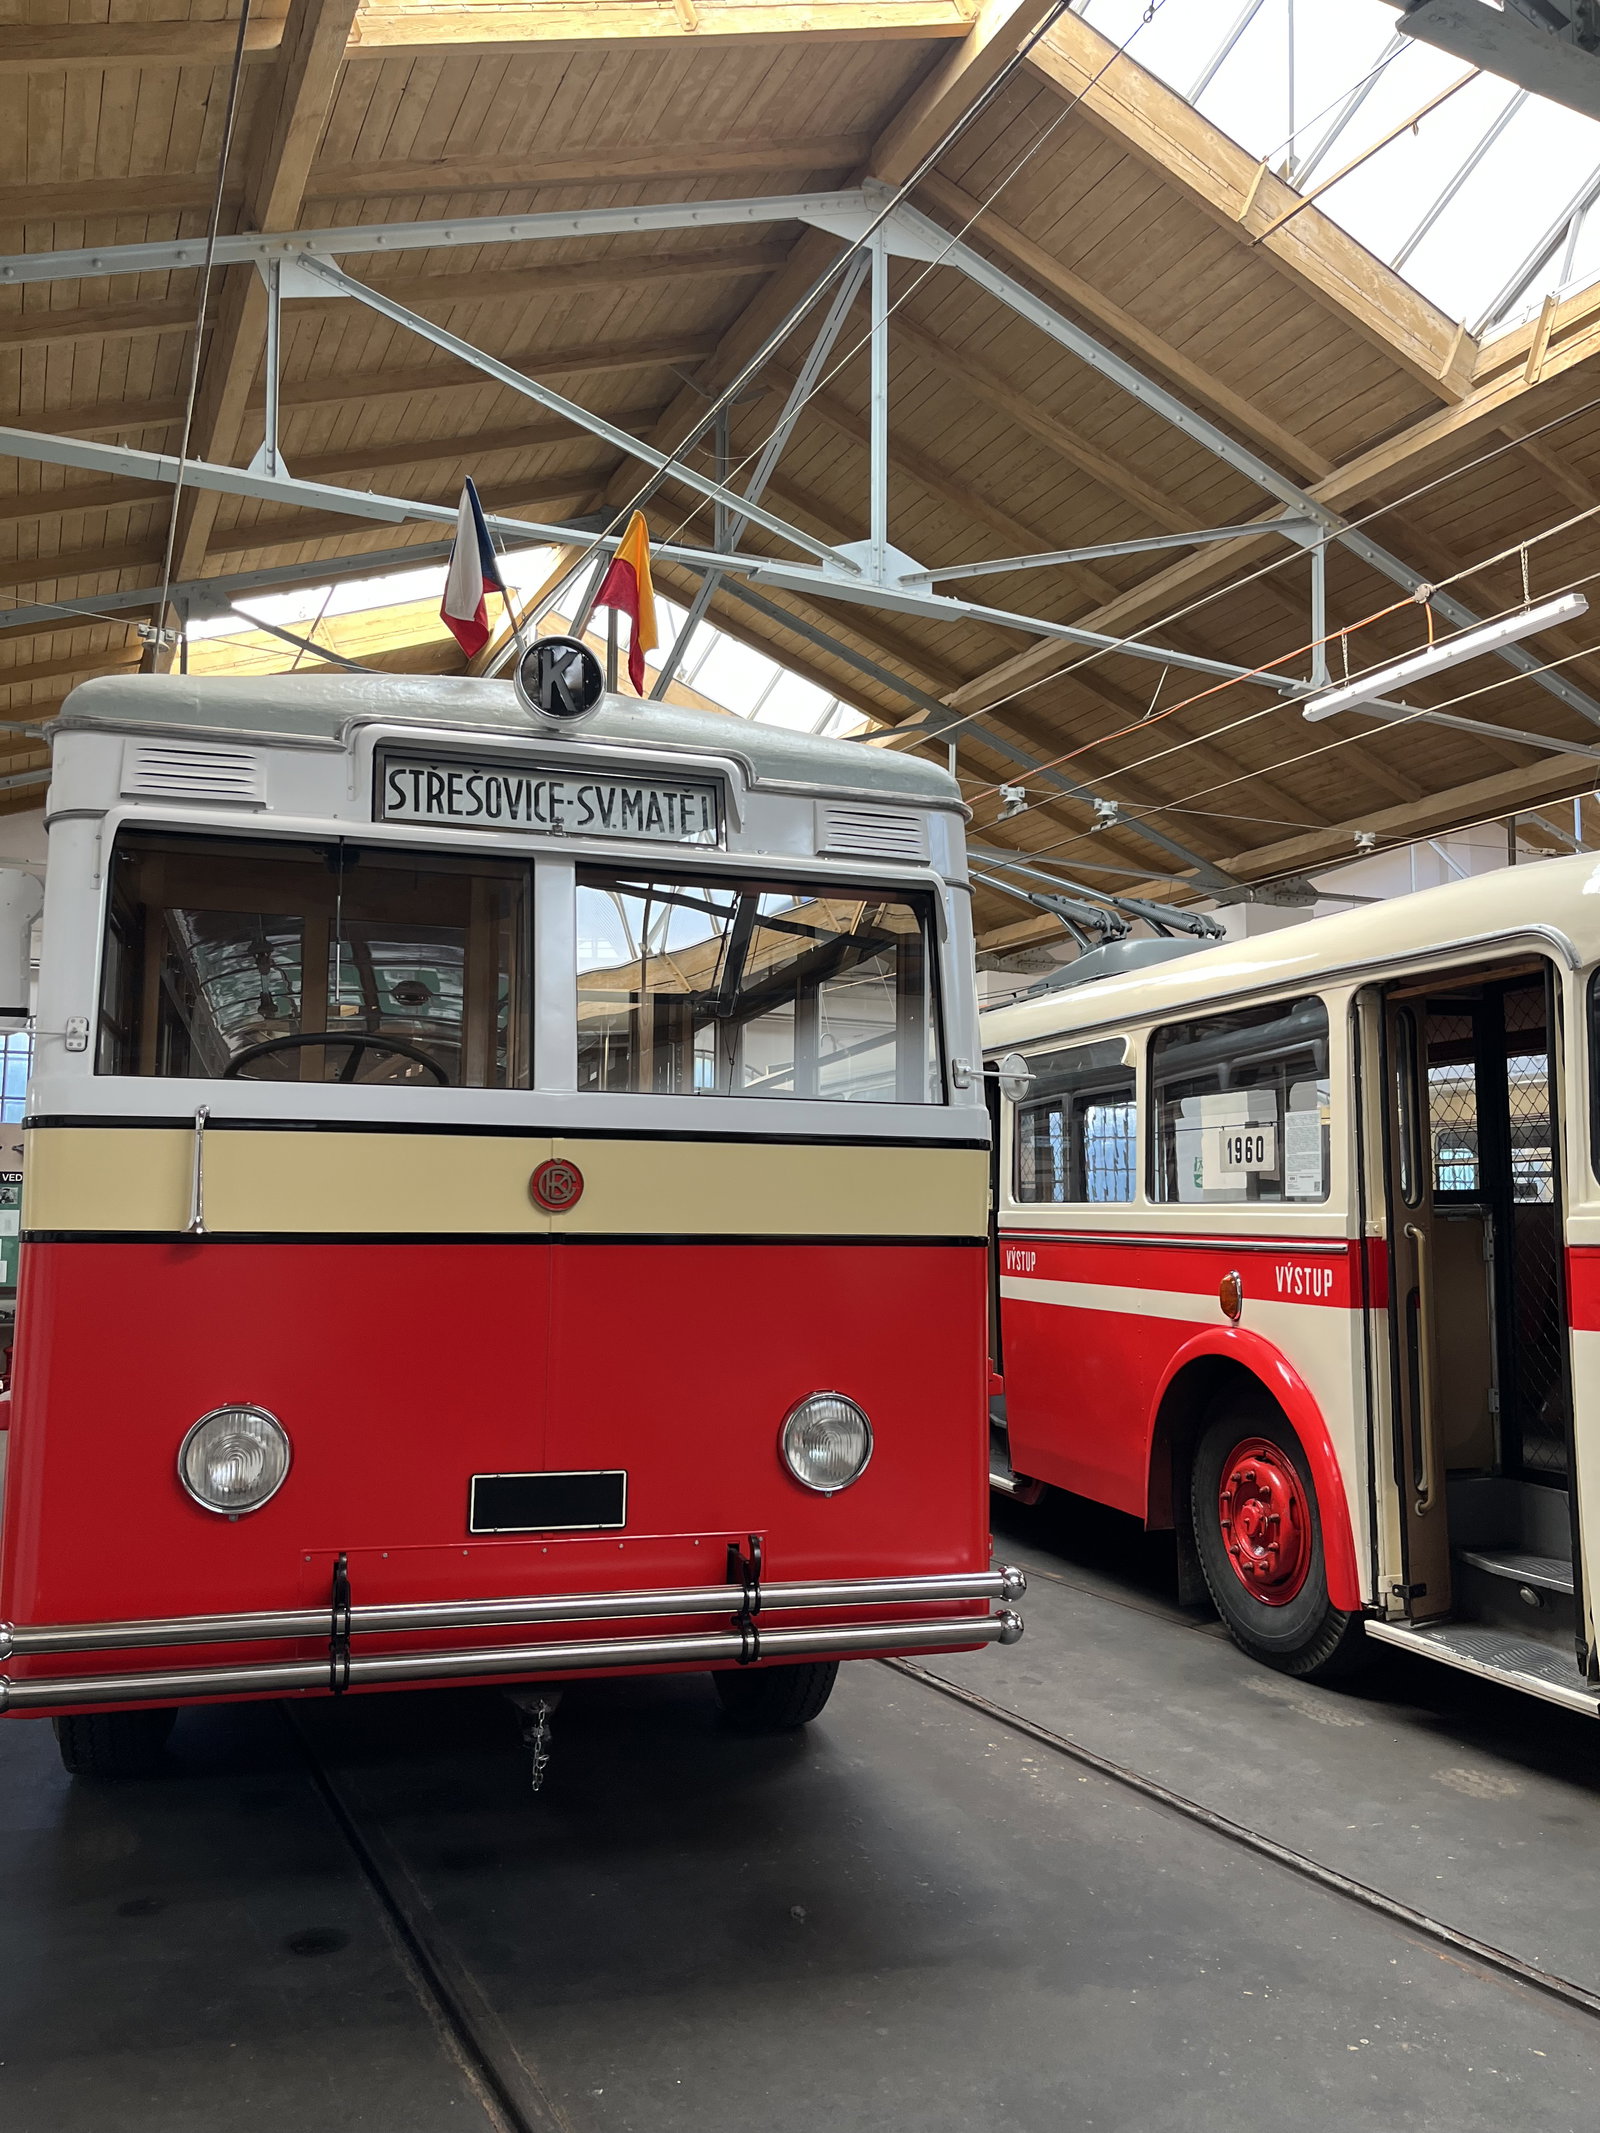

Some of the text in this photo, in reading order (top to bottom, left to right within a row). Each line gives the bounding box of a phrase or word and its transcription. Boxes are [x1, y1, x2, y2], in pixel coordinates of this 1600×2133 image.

[541, 649, 577, 712] K
[1227, 1135, 1264, 1165] 1960
[1006, 1249, 1037, 1272] VÝSTUP
[1275, 1262, 1333, 1297] VÝSTUP
